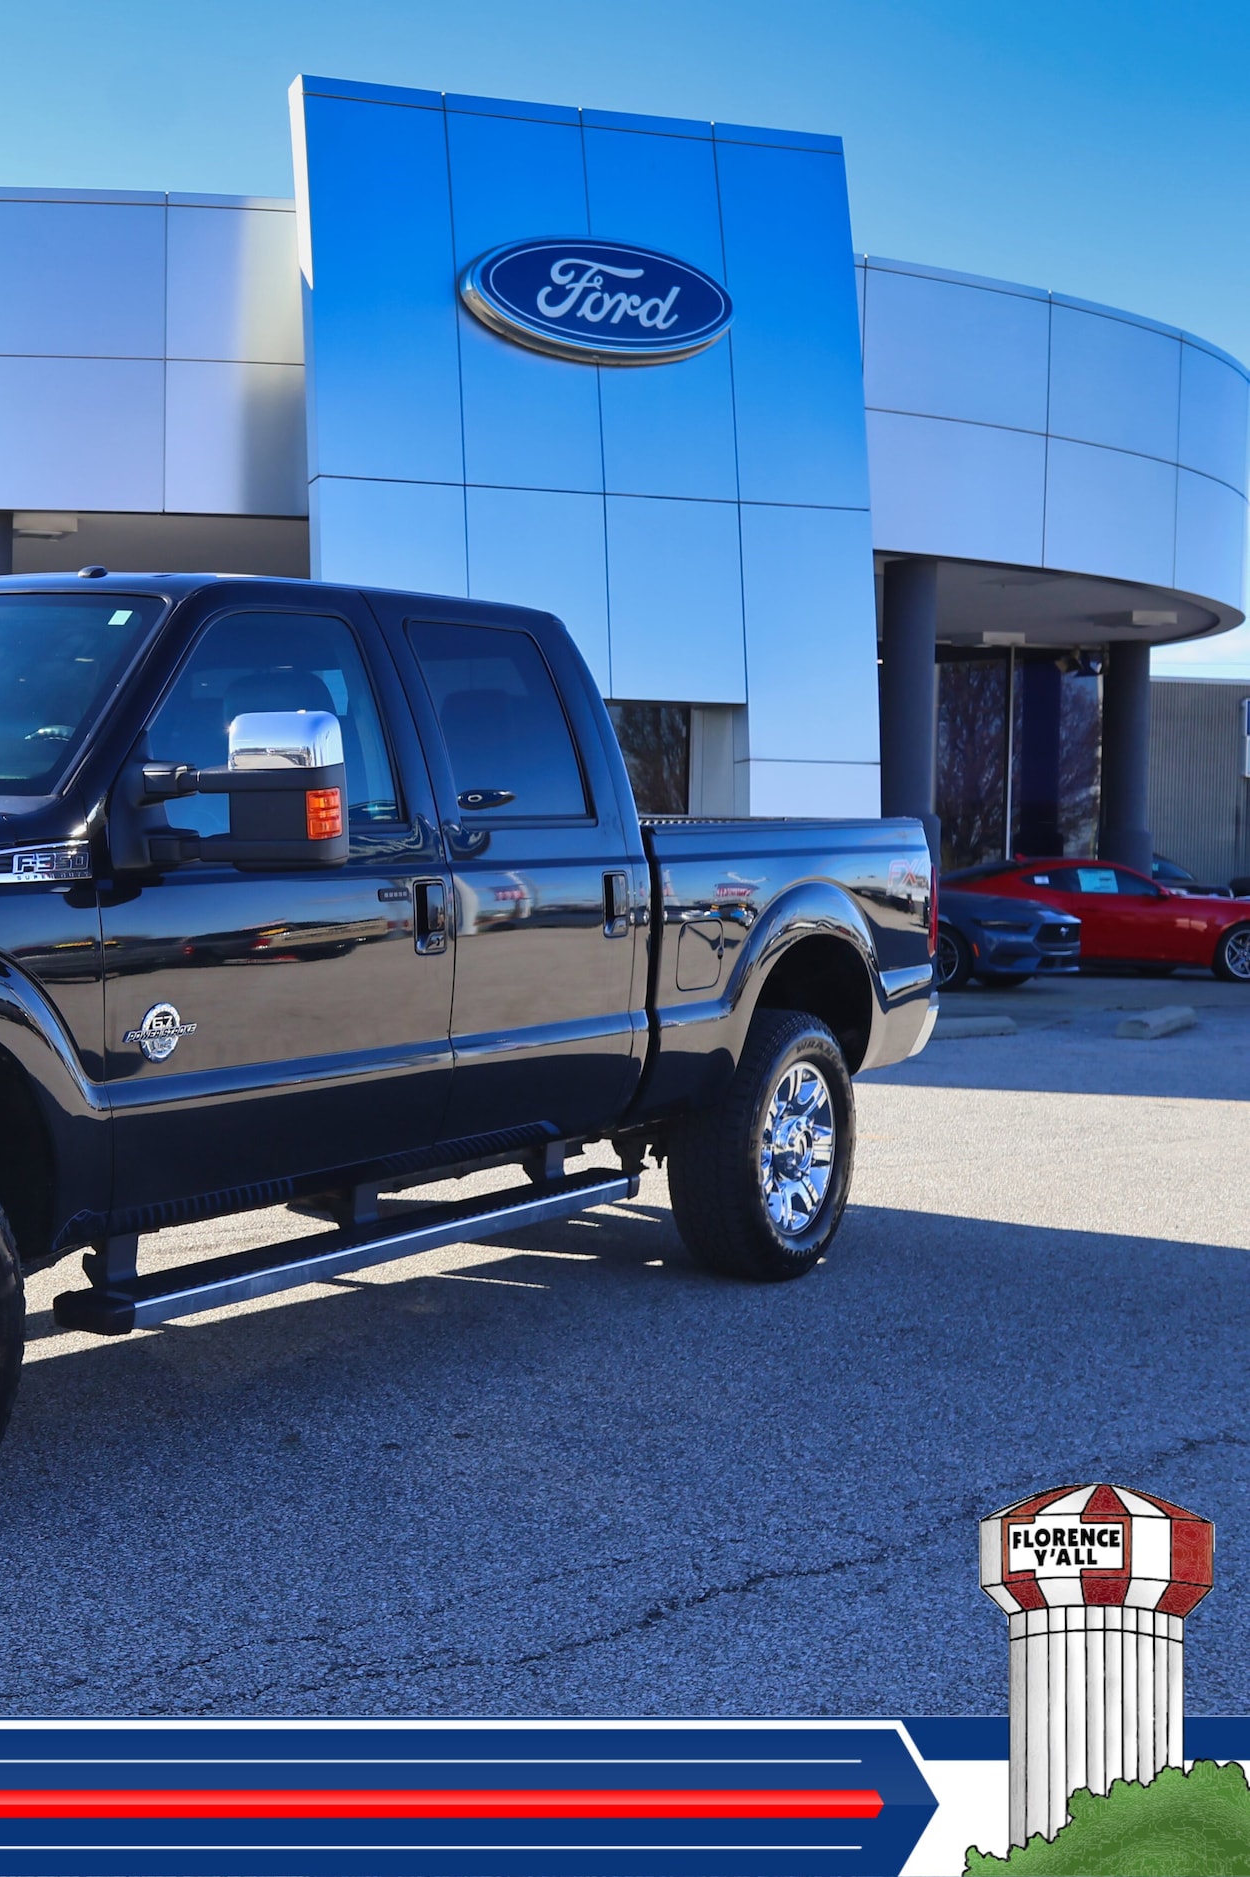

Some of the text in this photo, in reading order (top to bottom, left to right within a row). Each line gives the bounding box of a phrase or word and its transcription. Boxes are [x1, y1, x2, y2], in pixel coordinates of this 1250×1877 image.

[537, 258, 681, 330] Ford
[129, 1023, 196, 1041] POWER STROKE
